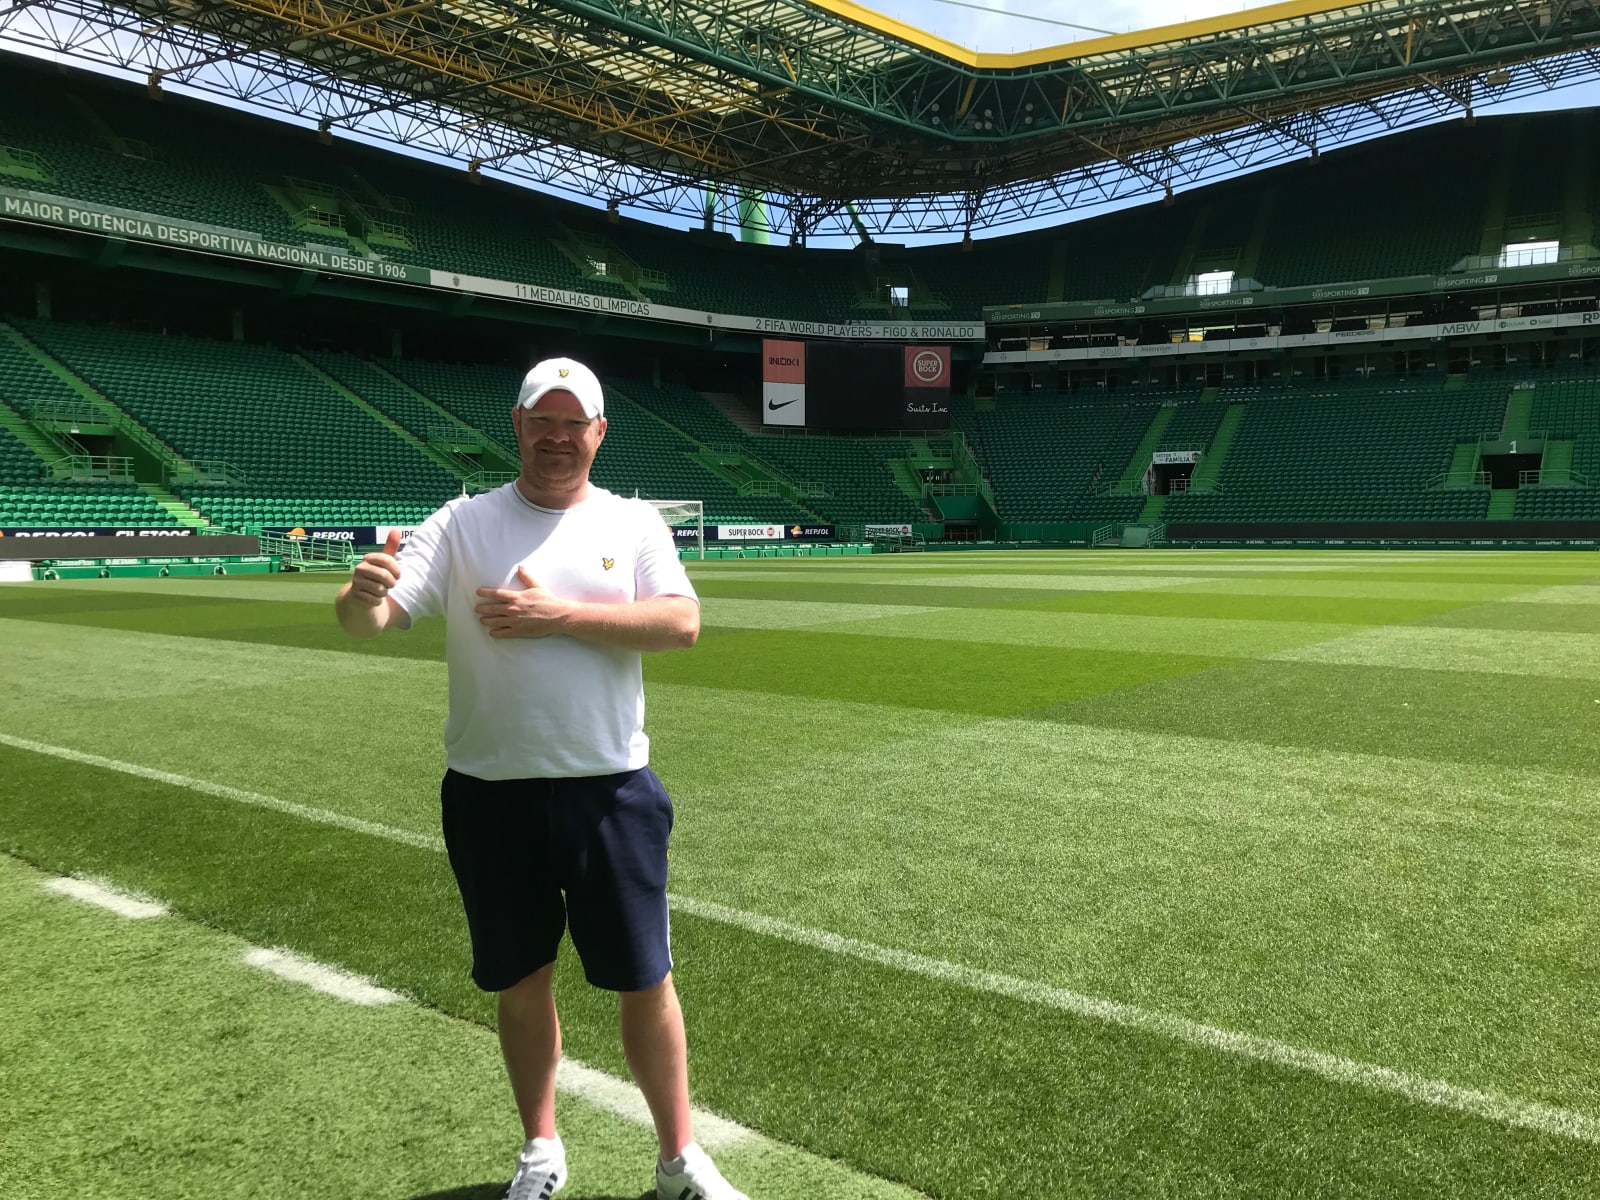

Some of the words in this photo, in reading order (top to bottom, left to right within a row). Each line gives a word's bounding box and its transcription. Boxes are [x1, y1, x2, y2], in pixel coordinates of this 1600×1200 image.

[5, 197, 64, 222] MAIOR
[69, 209, 153, 238] POTÊNCIA
[157, 225, 254, 255] DESPORTIVA
[257, 243, 328, 267] NACIONAL
[331, 255, 375, 274] DESDE
[378, 263, 406, 279] 1906
[1447, 277, 1484, 286] SPORTING
[1324, 289, 1357, 298] SPORTING
[515, 284, 527, 298] 11
[530, 287, 590, 308] MEDALHAS
[593, 296, 650, 316] OLÍMPICAS
[1211, 298, 1242, 306] SPORTING
[1103, 307, 1135, 315] SPORTING
[1001, 312, 1031, 320] SPORTING
[755, 319, 762, 329] 2
[764, 319, 786, 333] FIFA
[789, 321, 825, 335] WORLD
[827, 324, 872, 337] PLAYERS
[883, 326, 908, 337] FIGO
[910, 326, 919, 338] &
[921, 327, 974, 338] RONALDO
[1442, 322, 1480, 334] MBW
[917, 359, 938, 367] SUPER
[1509, 440, 1517, 454] 1
[312, 531, 355, 540] REPSOL
[728, 528, 747, 536] SUPER
[747, 528, 764, 536] BOCK
